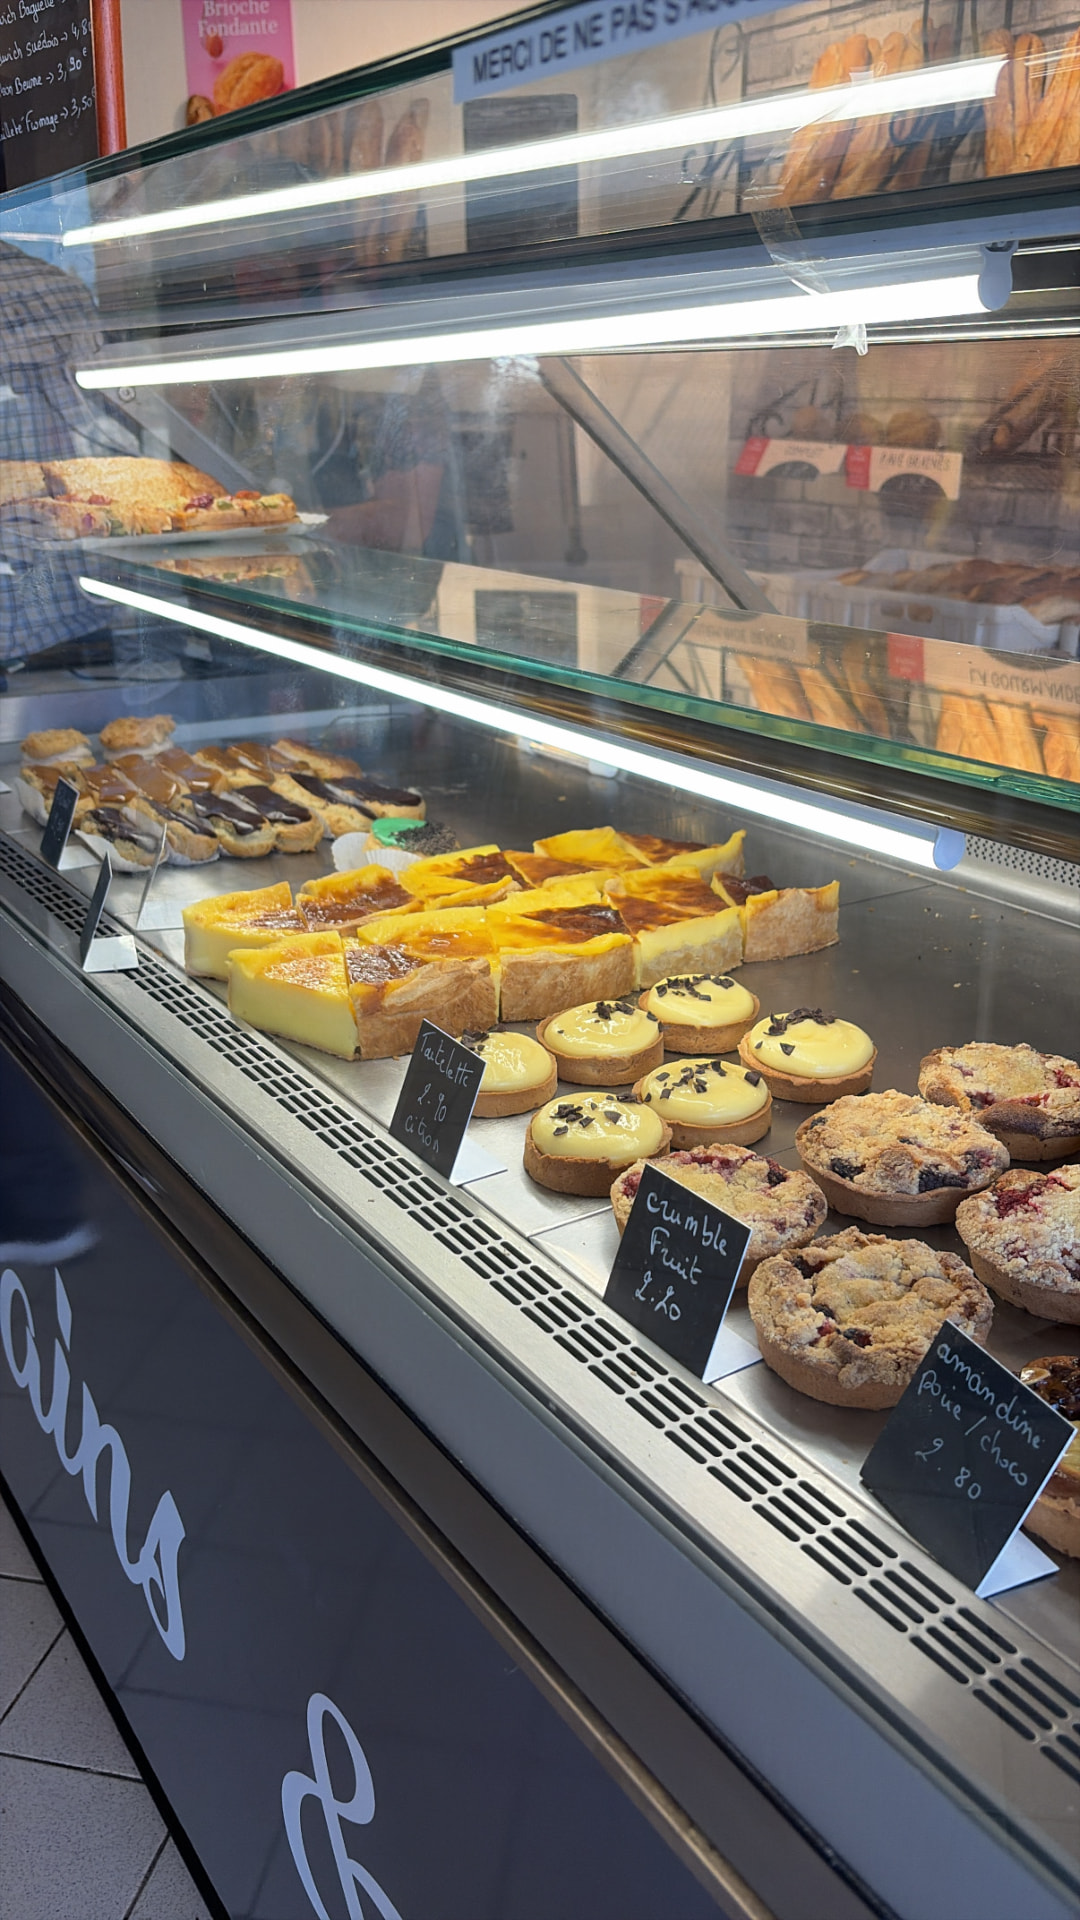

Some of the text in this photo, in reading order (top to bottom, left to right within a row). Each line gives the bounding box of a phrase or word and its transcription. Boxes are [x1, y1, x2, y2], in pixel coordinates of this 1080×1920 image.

[198, 17, 279, 38] Fondante
[203, 0, 270, 17] Brioche
[473, 39, 533, 84] MERCI
[540, 24, 568, 63] DE
[573, 13, 604, 51] NE
[611, 0, 656, 41] PAS
[650, 1226, 702, 1285] Fruit
